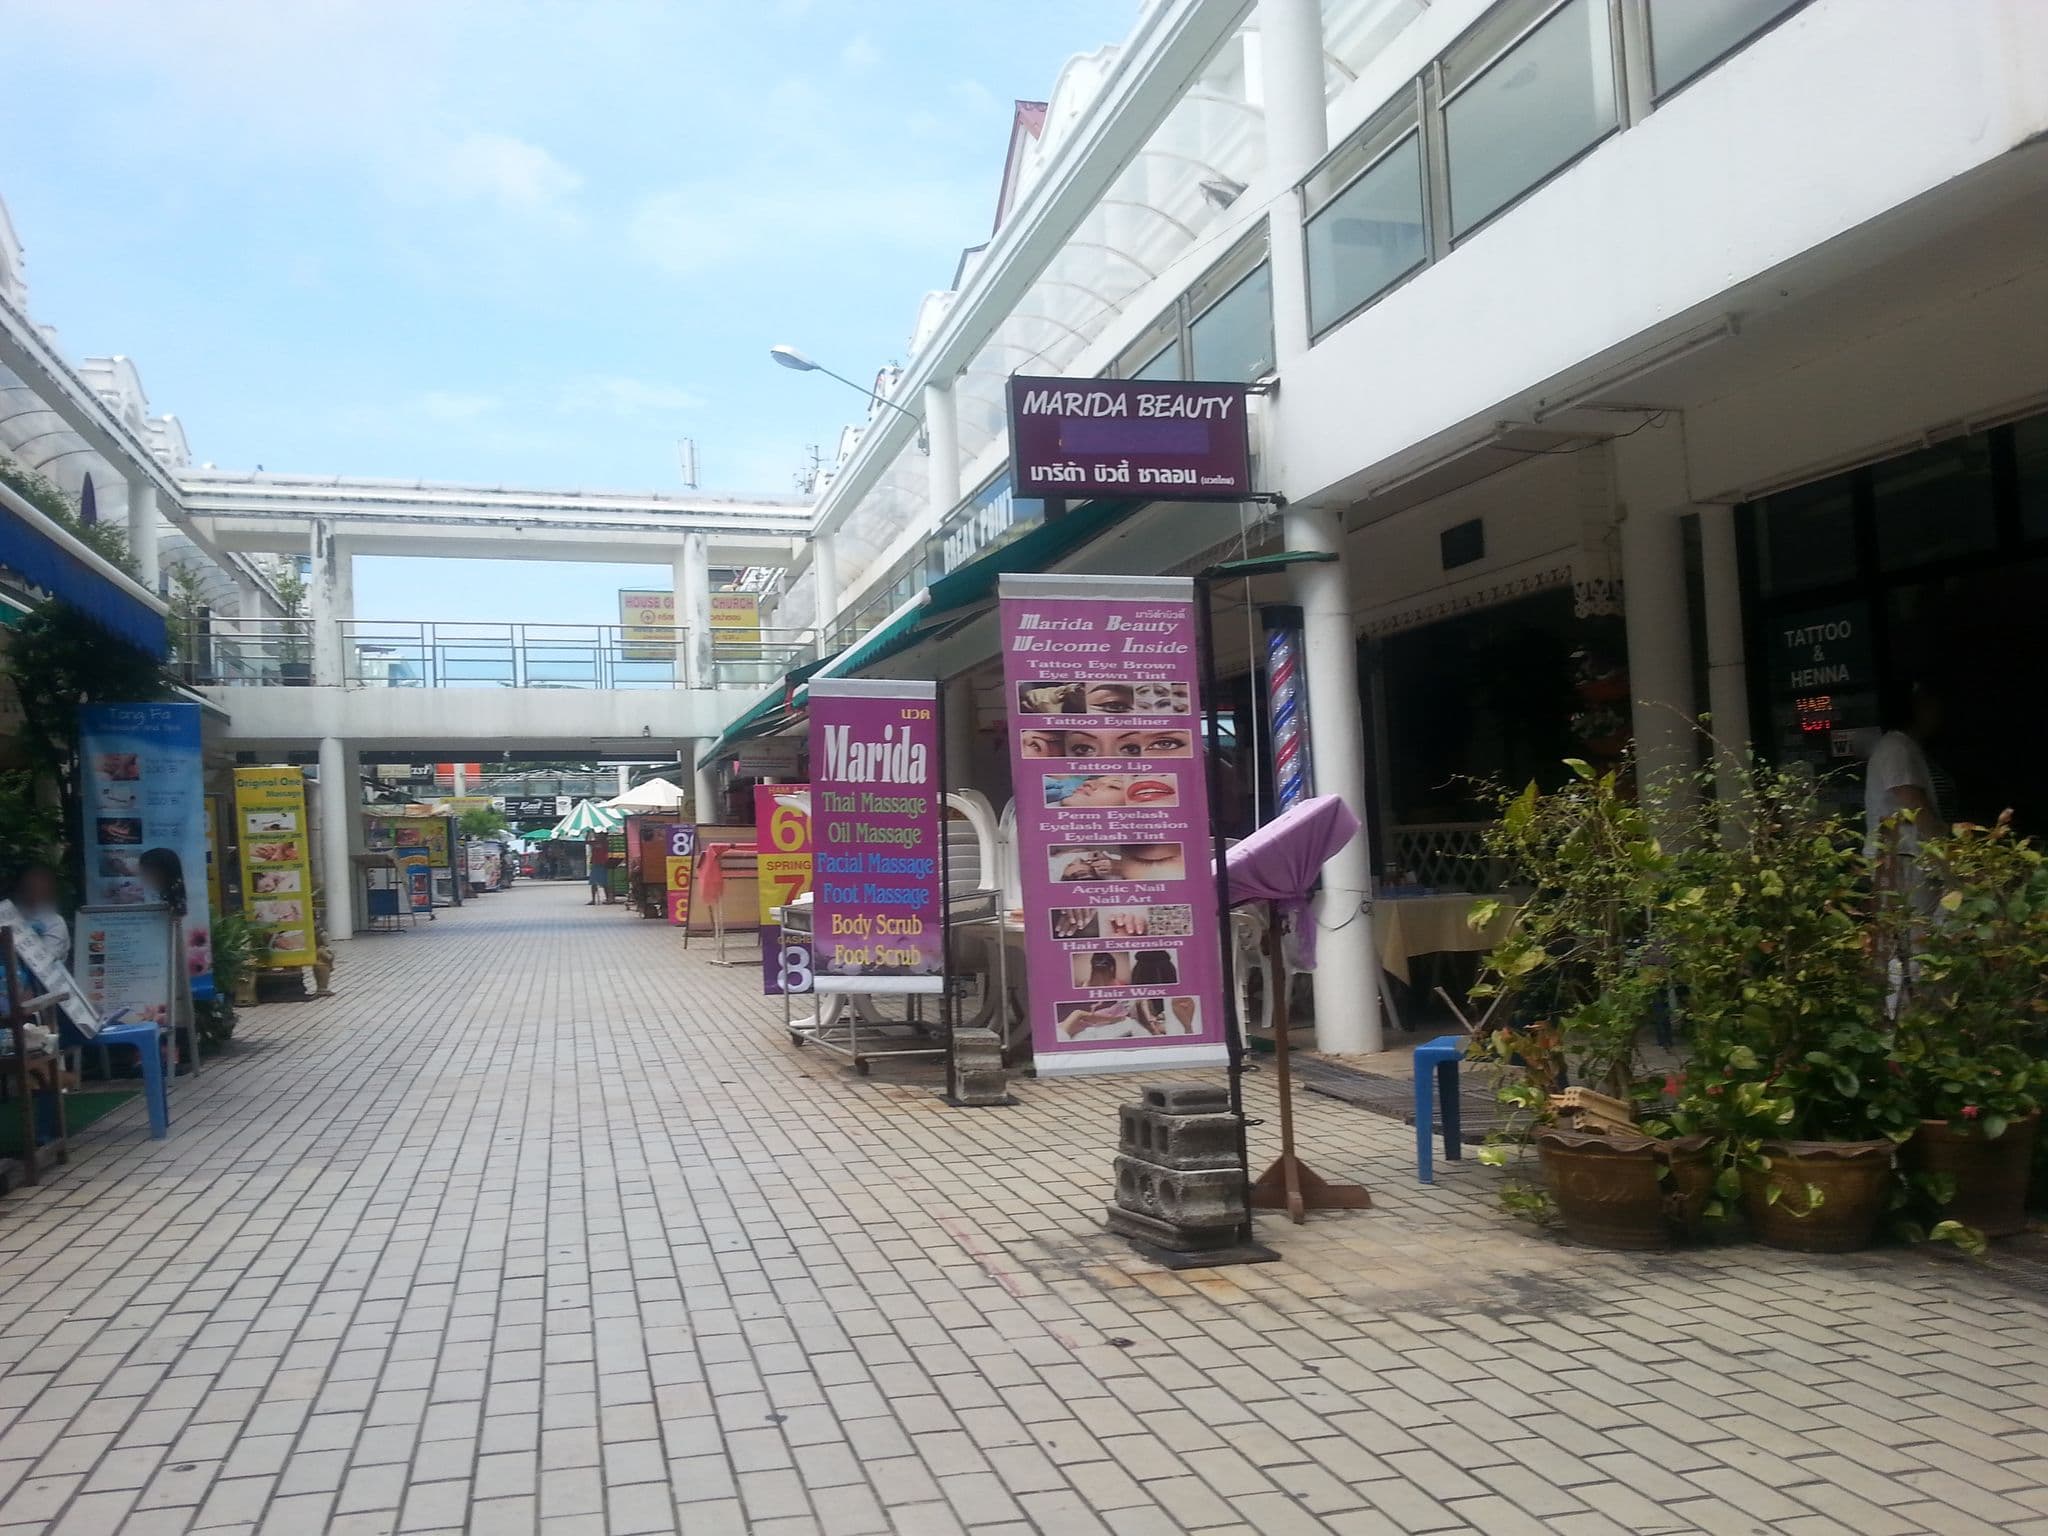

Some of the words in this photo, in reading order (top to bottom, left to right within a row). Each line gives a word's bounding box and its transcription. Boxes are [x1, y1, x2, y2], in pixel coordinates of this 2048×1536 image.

[1022, 390, 1128, 417] MARIDA
[1136, 394, 1233, 419] BEAUTY
[624, 596, 661, 609] HOUSE
[712, 597, 754, 609] CHURCH
[1018, 614, 1094, 631] Marida
[1105, 615, 1178, 635] Beauty
[1783, 620, 1851, 648] TATTOO
[1012, 635, 1111, 652] Welcome
[1122, 637, 1189, 654] Inside
[1813, 644, 1825, 662] &
[1026, 659, 1082, 669] Tattoo
[1088, 660, 1117, 670] Eye
[1123, 660, 1176, 670] Brown
[1039, 670, 1068, 680] Eye
[1075, 670, 1127, 680] Brown
[1133, 671, 1166, 680] Tint
[1791, 663, 1850, 688] HENNA
[901, 708, 931, 720] นวด
[1043, 716, 1098, 726] Tattoo
[1104, 717, 1170, 727] Eyeliner
[820, 723, 927, 784] Marida
[1067, 761, 1122, 771] Tattoo
[1128, 761, 1152, 772] Lip
[821, 791, 856, 813] Thai
[861, 791, 927, 818] Massage
[1057, 811, 1100, 820] Perm
[1107, 810, 1169, 821] Eyelash
[1040, 822, 1102, 832] Eyelash
[1109, 820, 1188, 830] Extension
[828, 822, 850, 843] Oil
[856, 822, 923, 848] Massage
[1064, 832, 1128, 842] Eyelash
[1133, 831, 1167, 841] Tint
[672, 832, 694, 856] 8
[766, 860, 812, 871] SPRING
[816, 851, 863, 873] Facial
[868, 853, 934, 880] Massage
[823, 882, 858, 904] Foot
[863, 884, 930, 910] Massage
[1072, 884, 1129, 895] Acrylic
[1135, 883, 1166, 892] Nail
[1089, 895, 1121, 904] Nail
[1126, 894, 1152, 904] Art
[831, 913, 872, 940] Body
[876, 914, 923, 935] Scrub
[1063, 941, 1100, 951] Hair
[1105, 939, 1184, 949] Extension
[834, 944, 870, 966] Foot
[876, 945, 921, 966] Scrub
[1089, 989, 1124, 999] Hair
[1131, 987, 1167, 997] Wax
